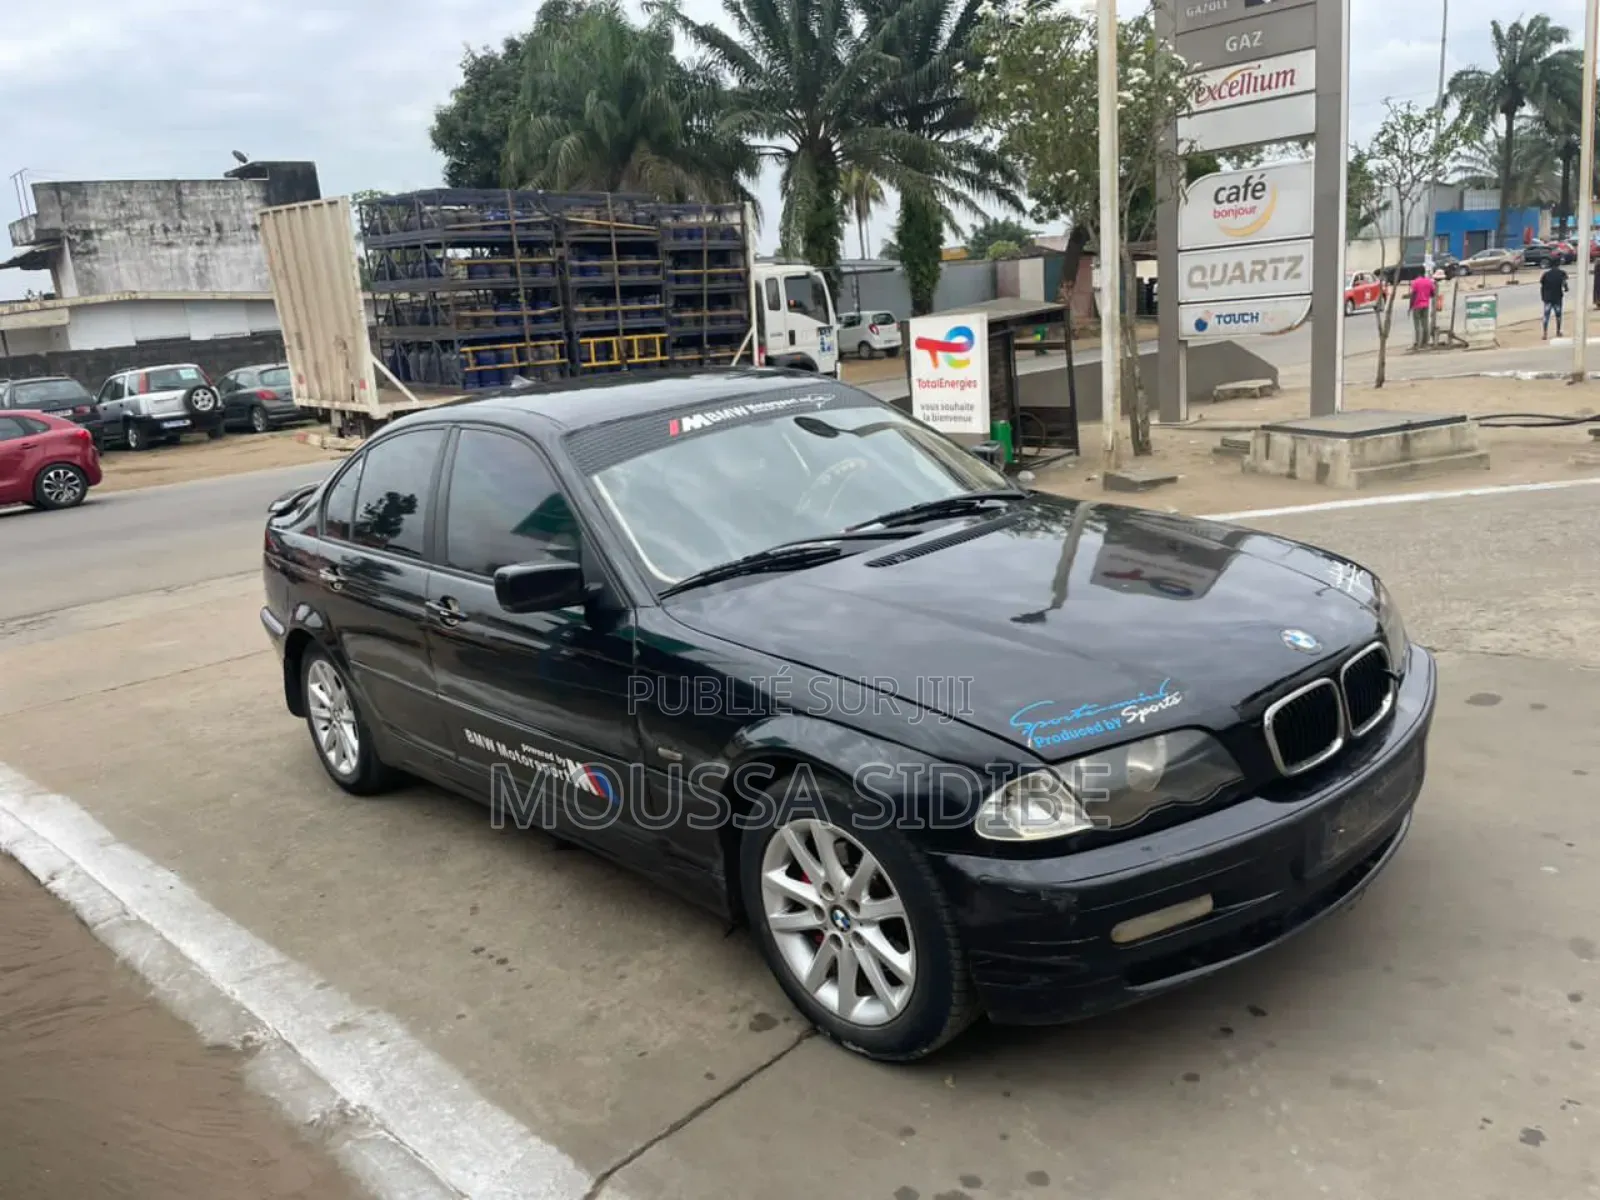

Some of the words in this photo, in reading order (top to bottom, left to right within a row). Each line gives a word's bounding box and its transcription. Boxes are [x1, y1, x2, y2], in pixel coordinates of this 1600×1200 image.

[1225, 30, 1263, 52] GAZ
[1194, 67, 1296, 105] excellium
[1213, 173, 1266, 205] café
[1213, 204, 1257, 220] bonjour
[1187, 253, 1304, 291] QUARTZ
[1215, 312, 1260, 325] TOUCH
[917, 378, 978, 391] TotalEnergies
[704, 405, 750, 422] BMW
[920, 402, 939, 411] vous
[941, 401, 975, 411] souhaite
[932, 412, 972, 422] bienvenue
[1034, 719, 1102, 748] Produced
[1121, 691, 1183, 723] Sports
[463, 728, 496, 752] BMW
